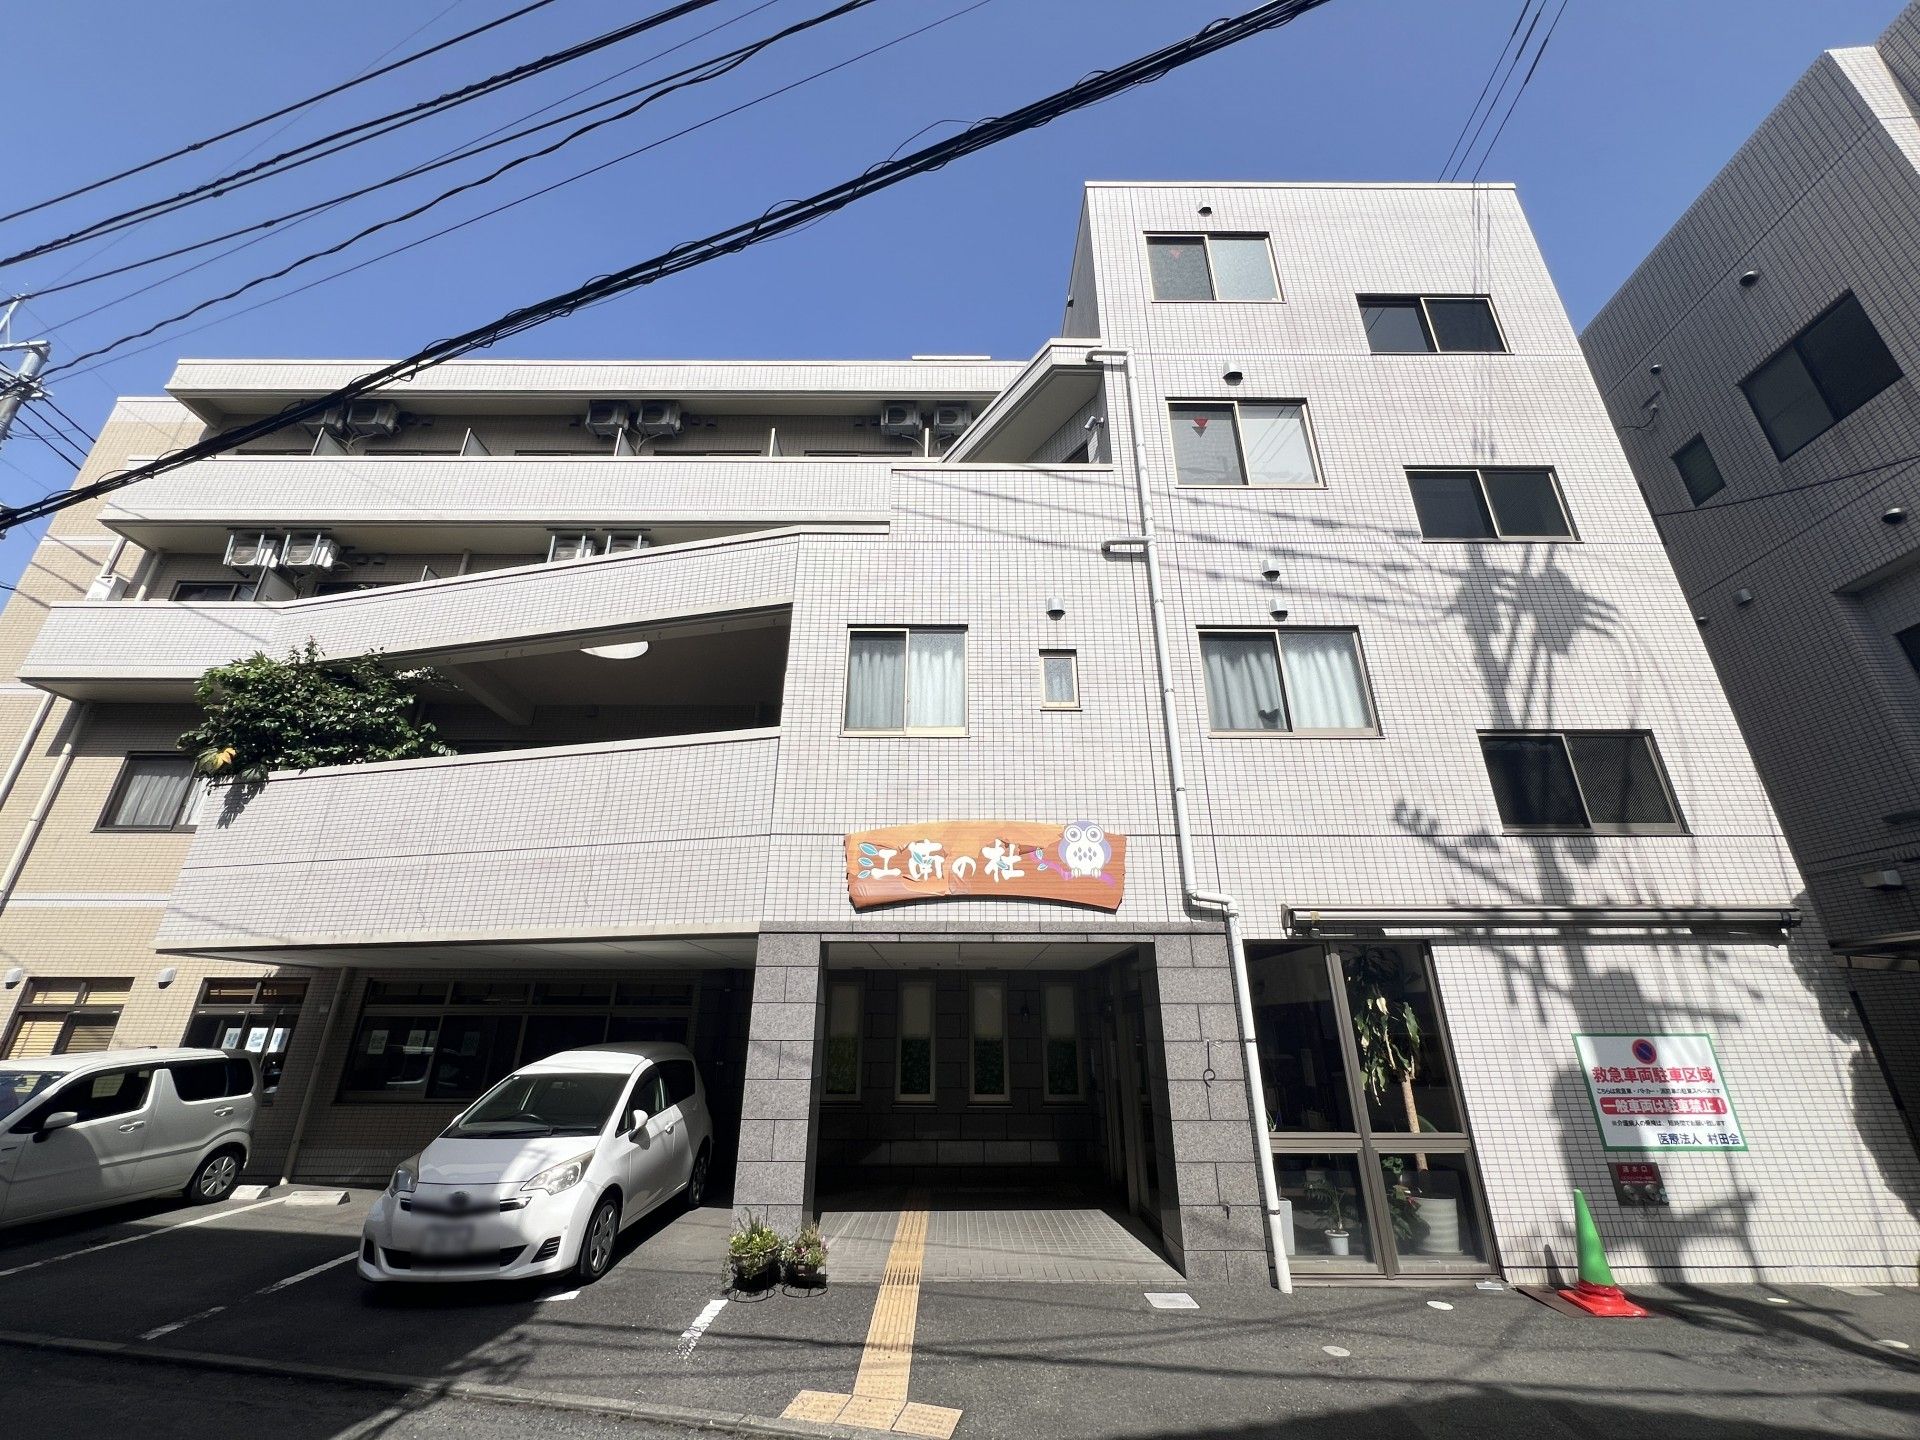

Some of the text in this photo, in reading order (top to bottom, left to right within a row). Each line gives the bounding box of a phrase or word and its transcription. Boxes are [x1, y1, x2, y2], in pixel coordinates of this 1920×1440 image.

[1592, 1066, 1715, 1083] 救急車両駐車区域
[1658, 1133, 1741, 1145] 医療法人 村田会
